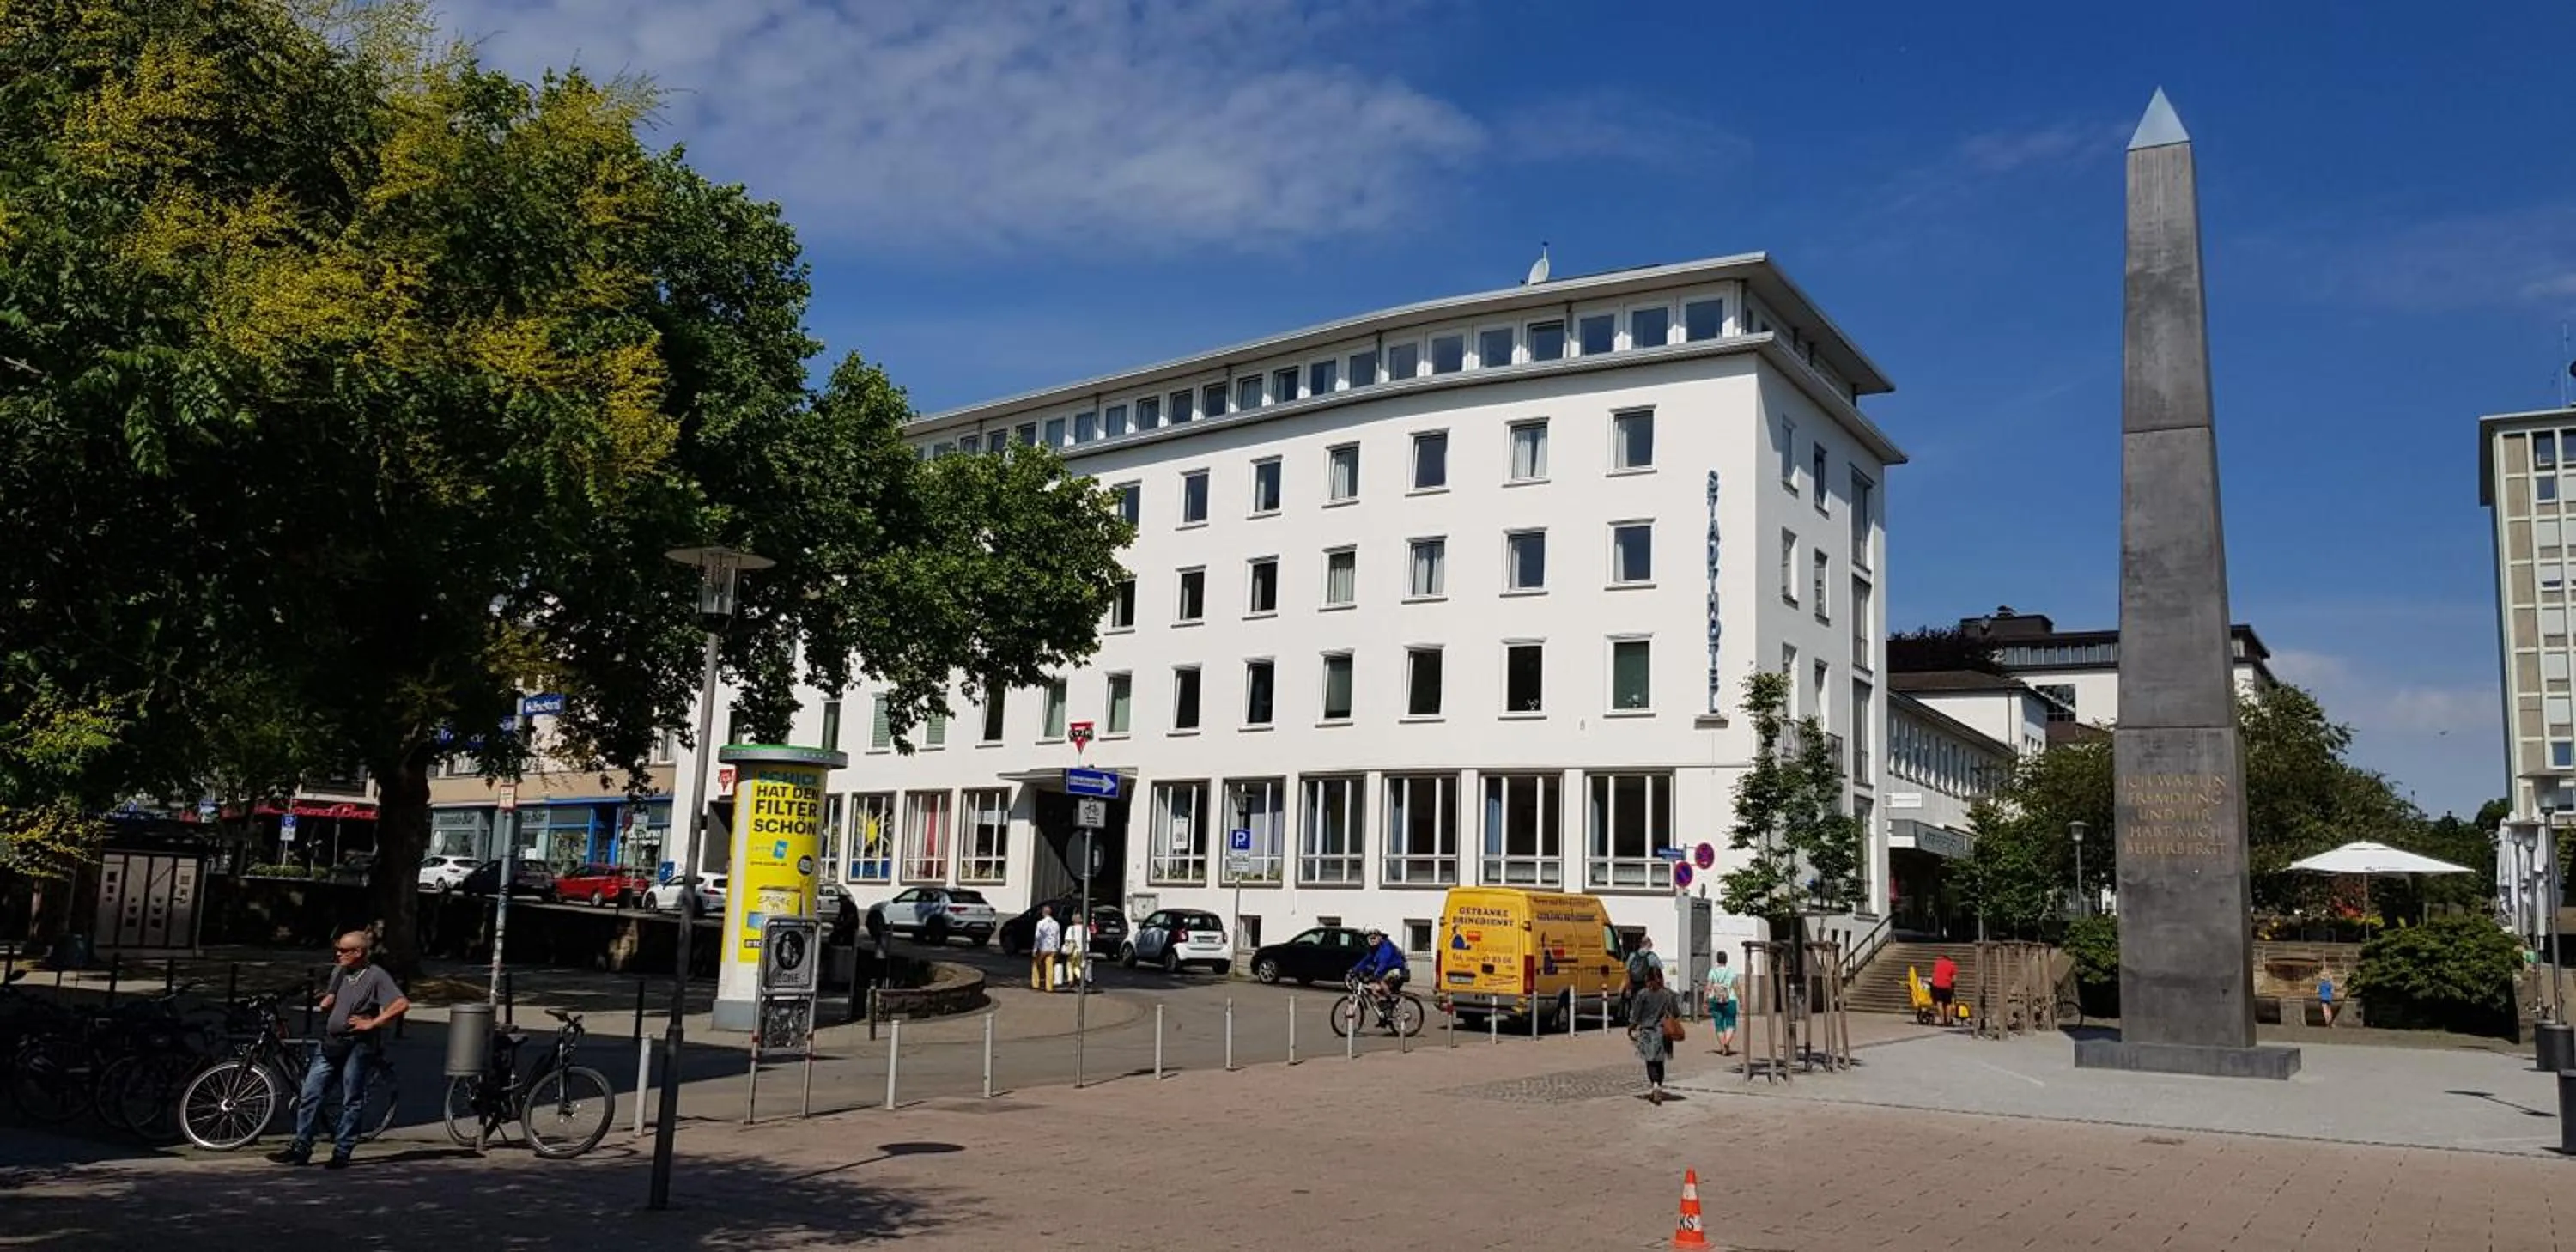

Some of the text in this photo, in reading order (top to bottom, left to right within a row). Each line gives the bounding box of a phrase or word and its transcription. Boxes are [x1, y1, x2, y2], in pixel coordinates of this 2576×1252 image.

[1706, 470, 1721, 714] STADTHOTEL
[2123, 775, 2152, 787] ICH
[2157, 775, 2194, 787] WAR
[756, 785, 820, 801] HAT DEN
[2127, 791, 2223, 805] FREMDLING
[755, 799, 818, 817] FILTER
[2137, 809, 2212, 822] UND IHR
[753, 815, 817, 835] SCHÖN
[2129, 824, 2222, 839] HABT MICH
[1236, 832, 1247, 848] P
[2123, 841, 2227, 855] BEHERBERGT
[1459, 906, 1510, 918] GETRÄNKE
[1452, 916, 1515, 927] BRINGDIENST
